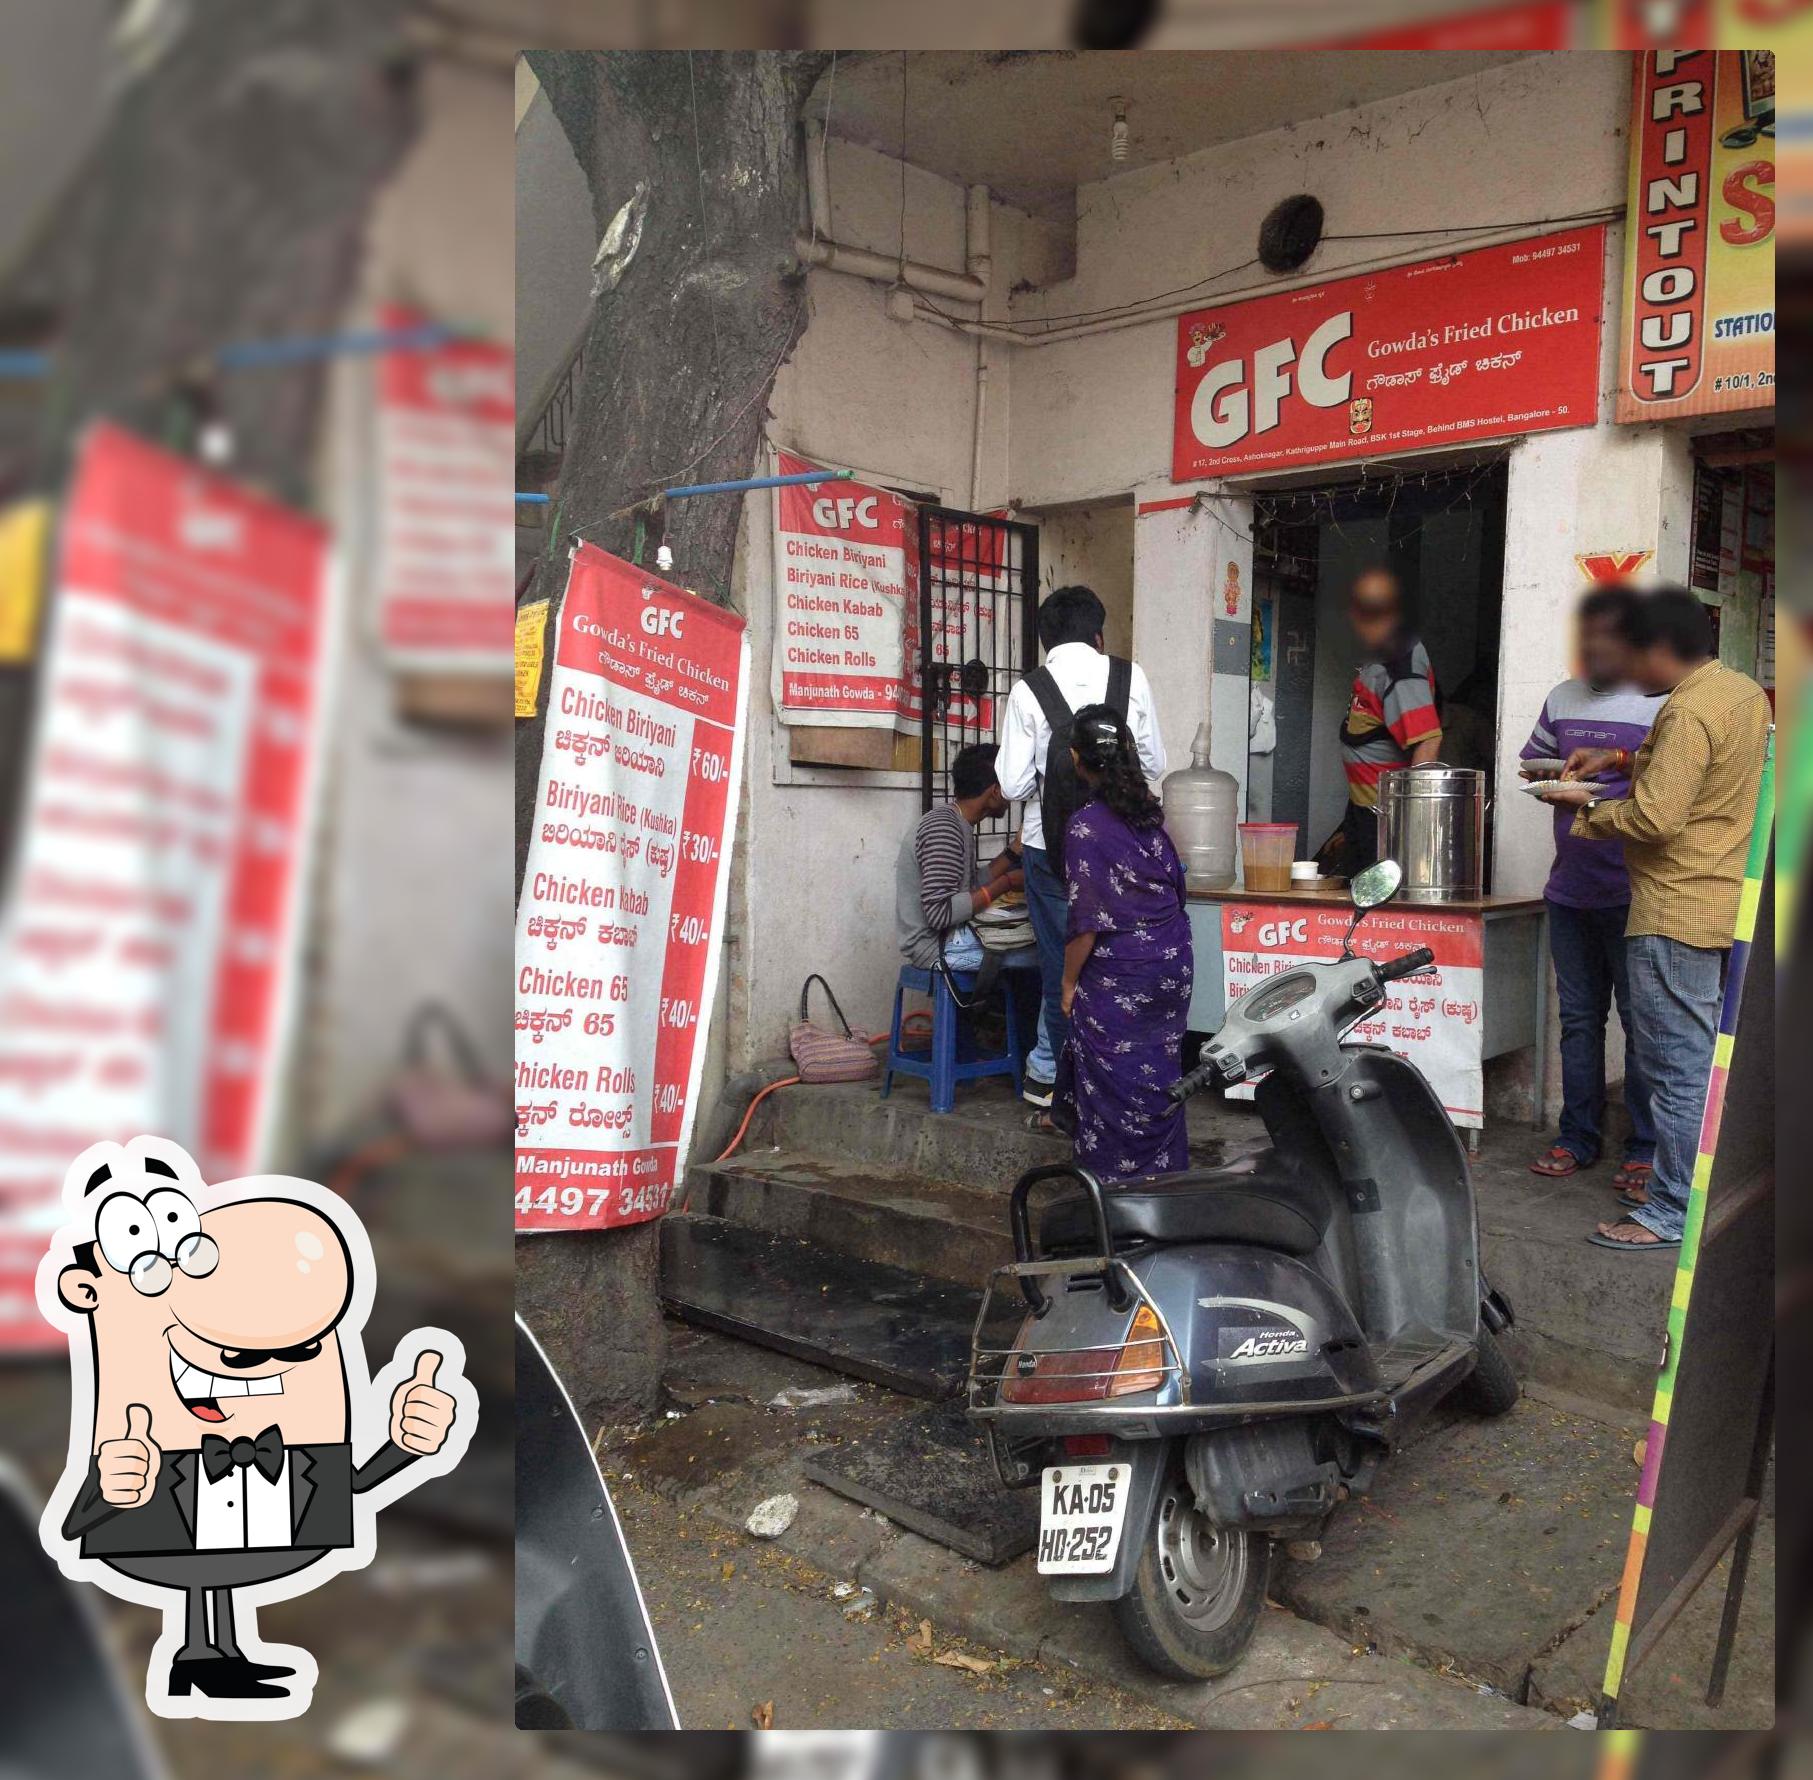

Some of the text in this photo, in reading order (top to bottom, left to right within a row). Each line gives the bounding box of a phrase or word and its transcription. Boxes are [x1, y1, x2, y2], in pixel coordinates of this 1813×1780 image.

[1512, 243, 1580, 264] Mob: 94497 34531
[1367, 308, 1579, 358] Gowda's Fried Chicken
[1715, 312, 1775, 338] STATIO
[1475, 350, 1523, 371] ಚಿಕನ್
[1190, 311, 1352, 448] GFC
[1758, 372, 1775, 386] 2n
[1208, 457, 1220, 466] 2nd
[1221, 455, 1242, 464] Cross,
[1285, 443, 1327, 456] Kathriguppe
[1329, 440, 1346, 449] Main
[1370, 432, 1387, 442] BSK
[1389, 431, 1401, 440] 1st
[1402, 428, 1426, 440] Stage,
[1427, 422, 1455, 434] Behind
[1456, 418, 1476, 430] BMS
[1477, 415, 1505, 427] Hostel,
[1507, 409, 1550, 424] Bangalore
[812, 496, 878, 530] GFC
[786, 540, 886, 568] Chicken Biriyani
[787, 567, 836, 588] Biriyani
[839, 573, 869, 589] Rice
[787, 594, 883, 617] Chicken Kabab
[641, 606, 684, 639] GFC
[787, 621, 859, 640] Chicken 65
[572, 615, 729, 691] Gowda's Fried Chicken
[787, 647, 876, 667] Chicken Rolls
[789, 682, 840, 700] Manjunath
[843, 685, 875, 700] Gowda
[561, 687, 676, 748] Chicken Biriyani
[546, 779, 677, 839] Biriyani Rice (Kushka)
[533, 872, 649, 917] Chicken Kabab
[1259, 918, 1308, 947] GFC
[1318, 913, 1464, 933] Gowds Fried Chicken
[1229, 957, 1296, 975] Chicken Biri
[519, 966, 628, 1002] Chicken 65
[1229, 982, 1251, 998] Biri
[583, 1012, 615, 1036] 65
[515, 1061, 636, 1094] hicken Rolls
[516, 1155, 658, 1178] Manjunath Gowda
[618, 1182, 668, 1216] 34531
[1260, 1330, 1296, 1340] Honda
[1231, 1338, 1308, 1359] Activa
